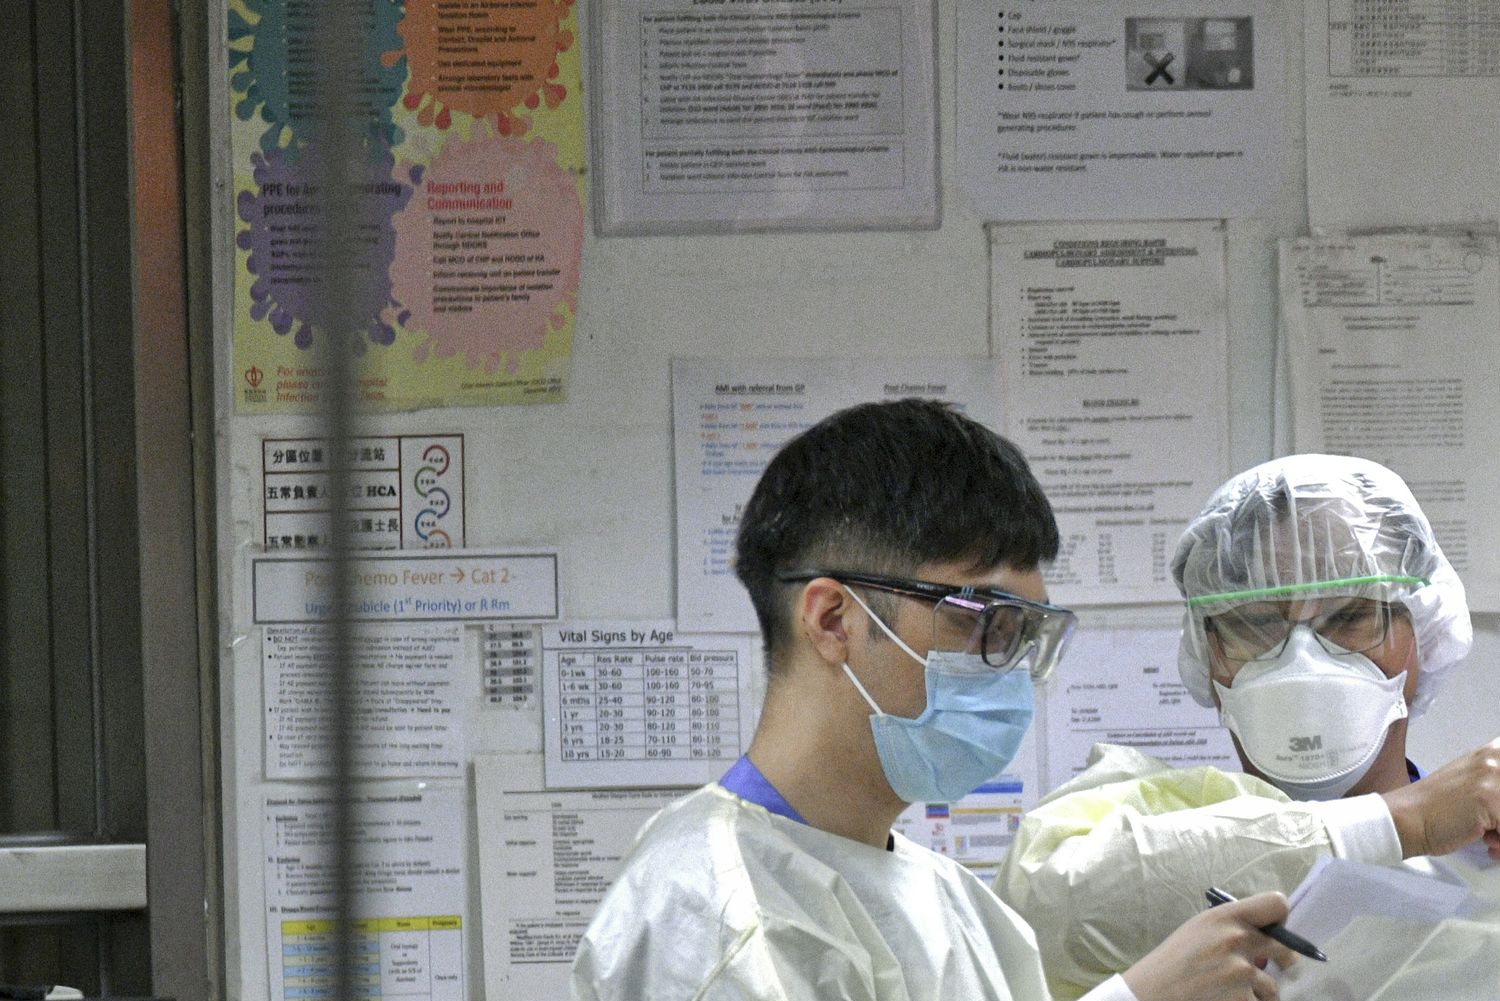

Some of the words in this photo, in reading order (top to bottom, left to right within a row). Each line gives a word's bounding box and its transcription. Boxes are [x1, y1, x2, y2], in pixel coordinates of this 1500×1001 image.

[427, 182, 478, 196] Reporting
[483, 182, 504, 194] and
[427, 197, 513, 211] Communication
[366, 485, 397, 498] HCA
[403, 570, 443, 584] Fever
[471, 570, 494, 584] Cat
[499, 568, 510, 583] 2
[416, 598, 462, 613] Priority)
[465, 601, 476, 611] or
[559, 629, 587, 643] Vital
[591, 629, 627, 645] Signs
[630, 629, 645, 645] by
[650, 629, 674, 645] Age
[561, 657, 576, 665] Age
[1289, 735, 1322, 752] 3M
